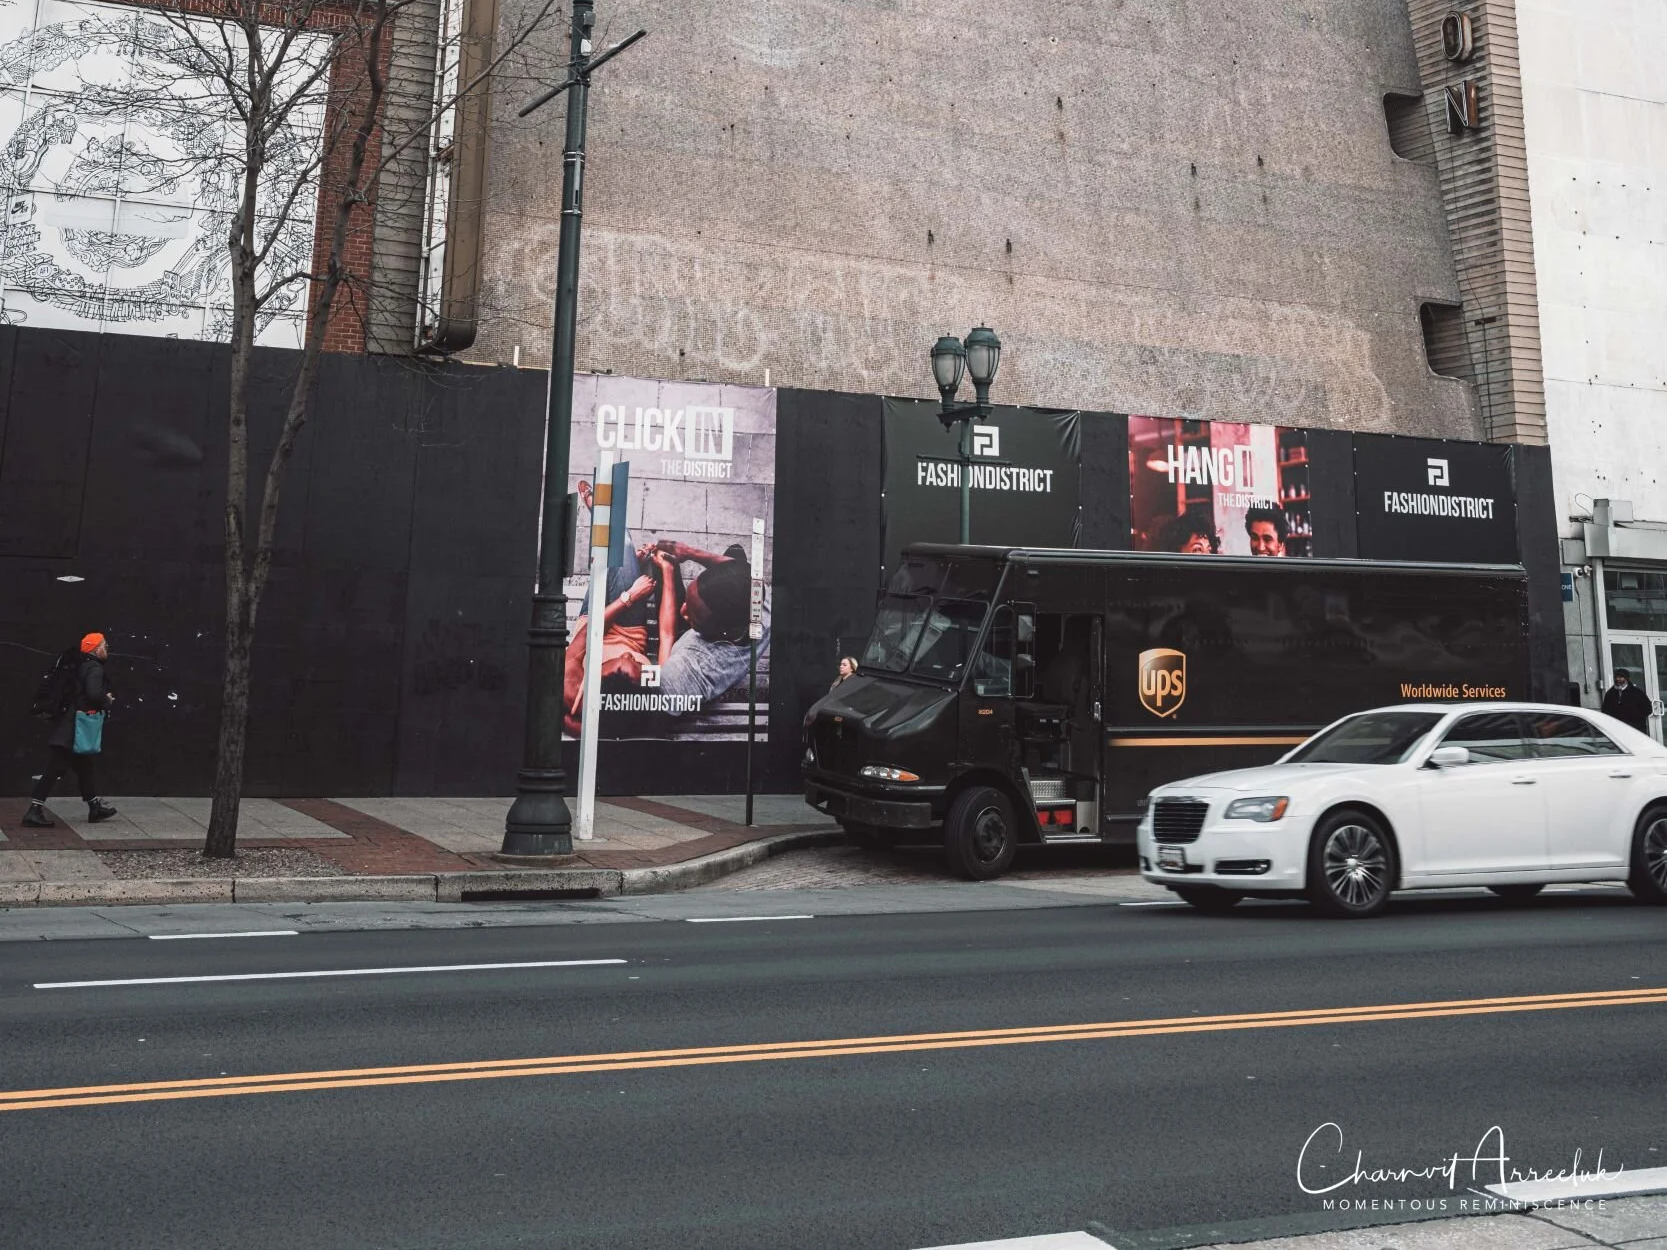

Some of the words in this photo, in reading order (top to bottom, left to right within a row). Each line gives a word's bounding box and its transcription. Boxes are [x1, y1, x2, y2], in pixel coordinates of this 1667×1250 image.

[596, 404, 684, 452] CLICK
[690, 407, 730, 458] IN
[661, 459, 682, 476] THE
[683, 461, 733, 478] DISTRICT
[1167, 444, 1236, 487] HANG
[1218, 492, 1236, 508] THE
[1235, 494, 1273, 510] DISTRICT
[1384, 491, 1494, 519] FASHIONDISTRICT
[1142, 669, 1183, 707] ups
[1401, 683, 1459, 698] Worldwide
[1462, 683, 1506, 698] Services
[600, 693, 703, 712] FASHIONDISTRICT
